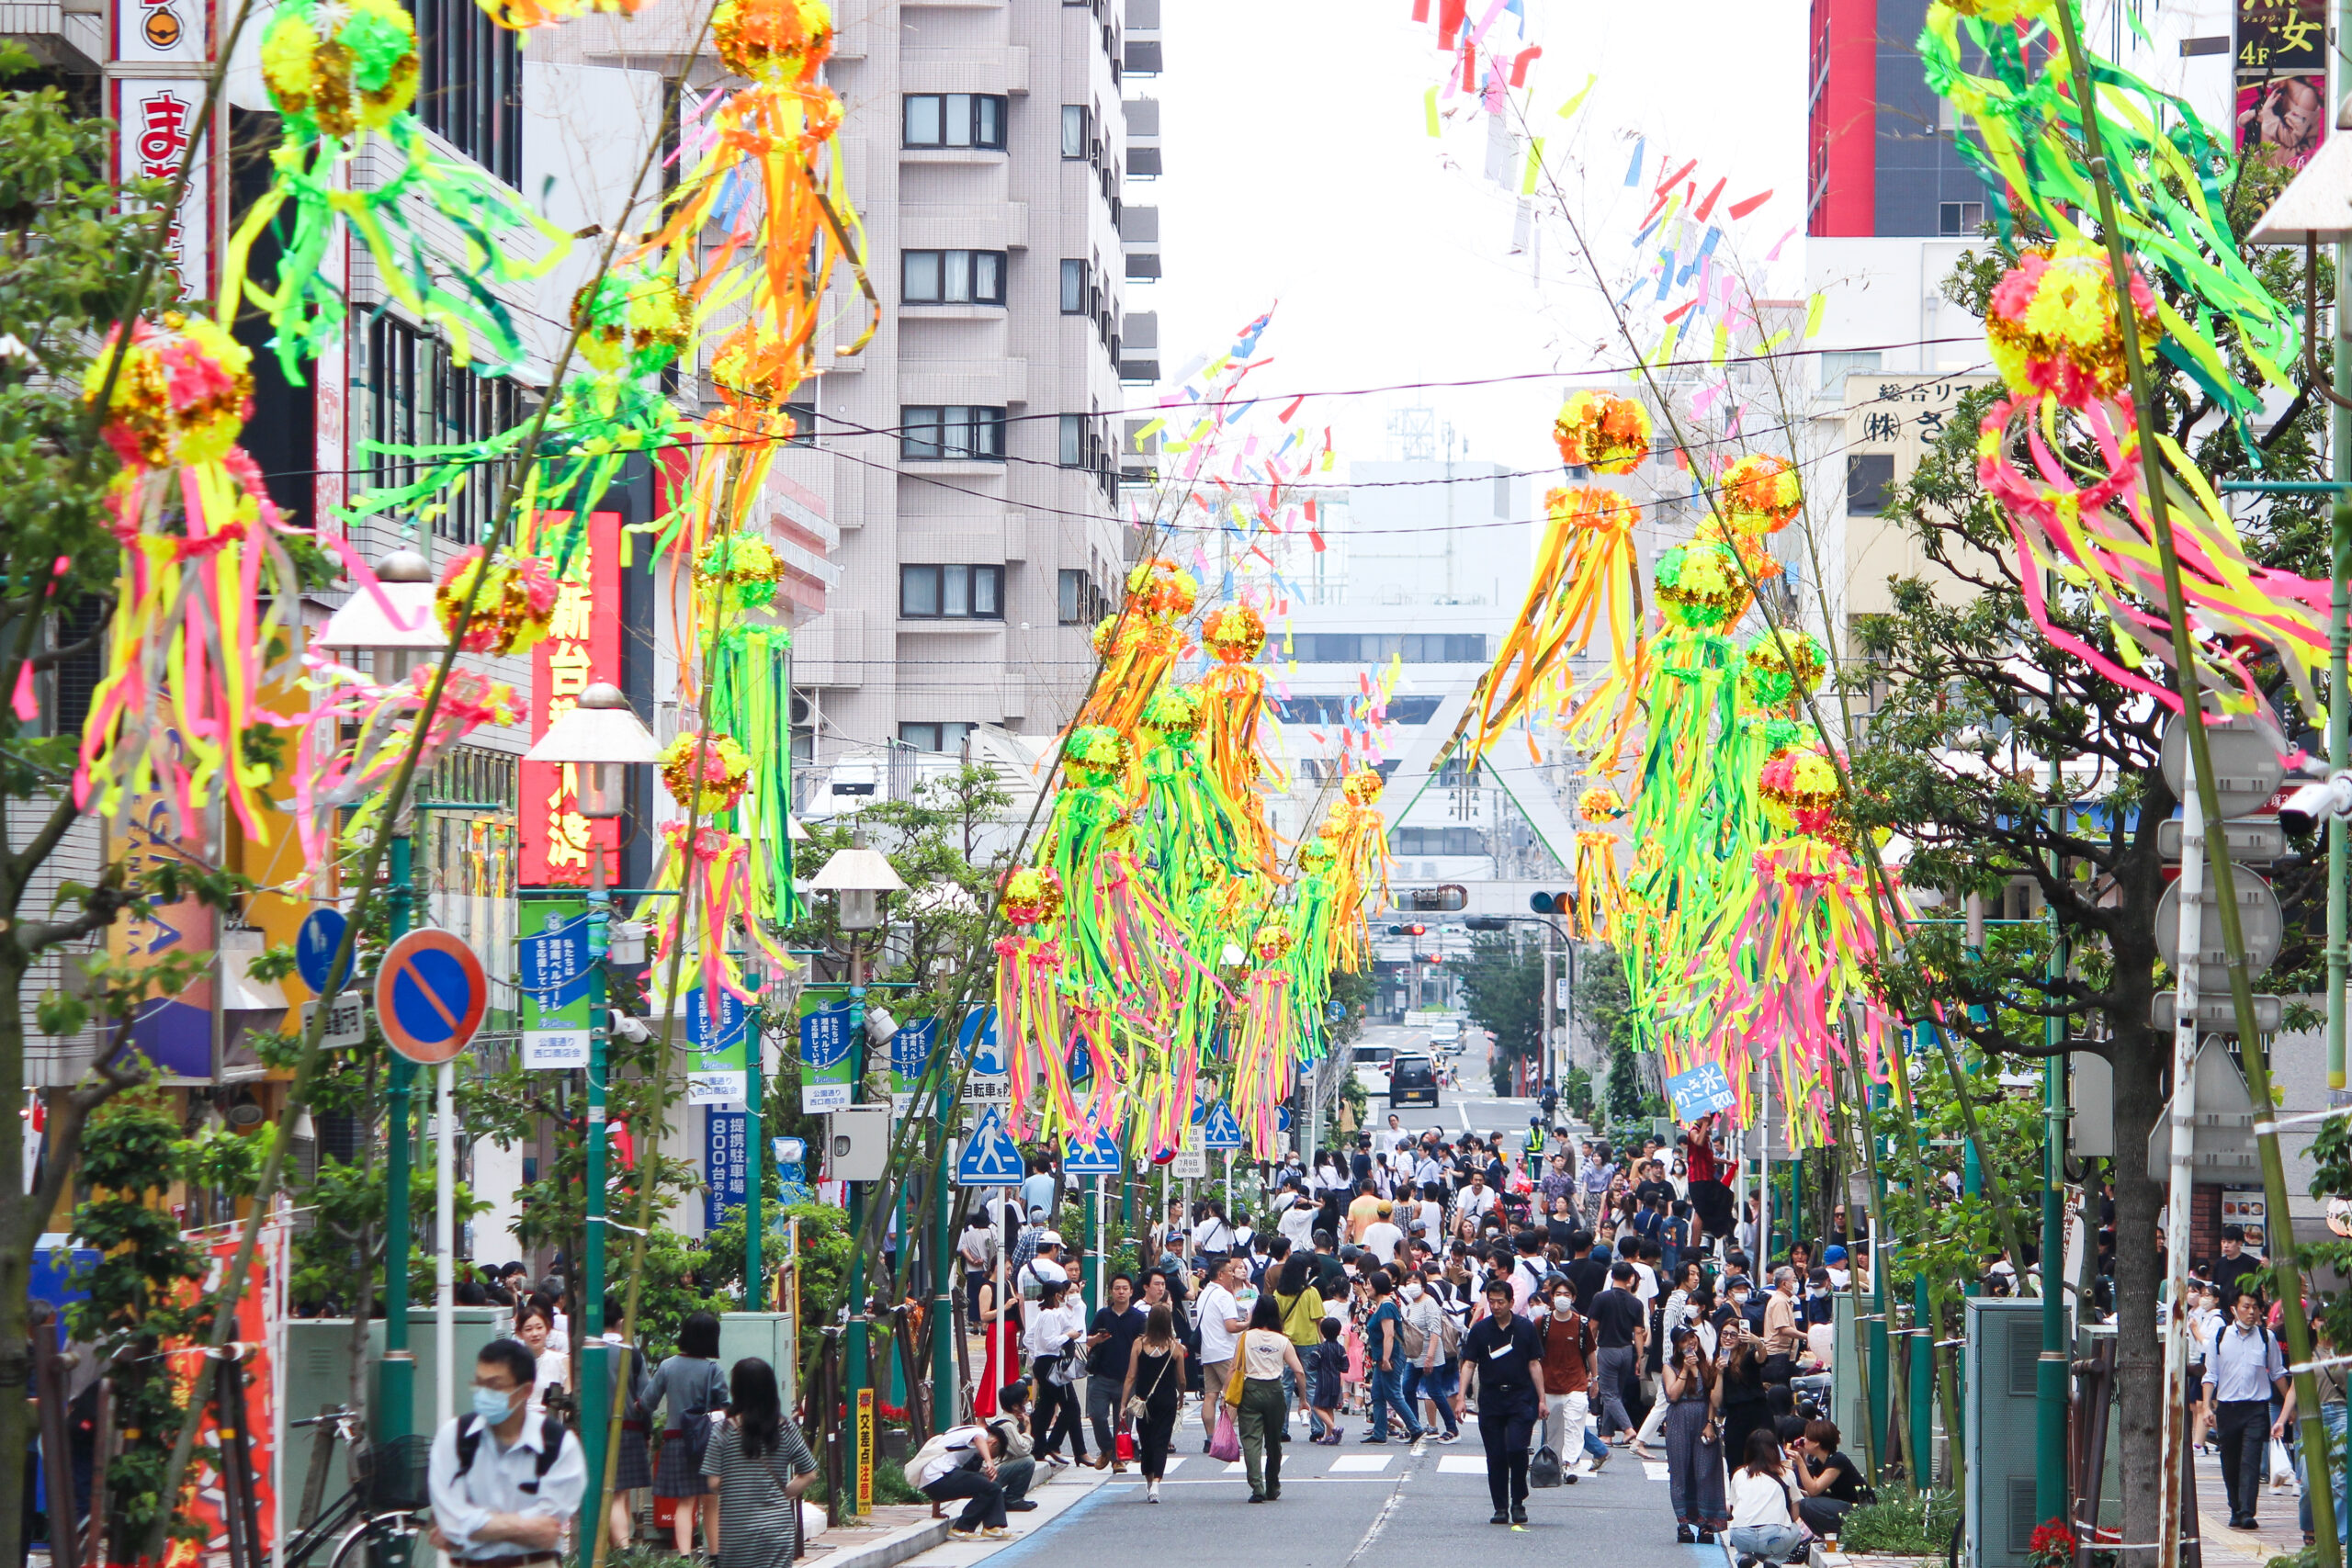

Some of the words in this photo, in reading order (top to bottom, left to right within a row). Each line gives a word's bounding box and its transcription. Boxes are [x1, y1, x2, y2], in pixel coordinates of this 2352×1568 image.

[2239, 40, 2270, 65] 4F
[563, 939, 575, 976] 私たちは
[722, 992, 732, 1025] 私たちは
[534, 1048, 581, 1058] 西口商店会
[538, 1037, 575, 1047] 公園通り
[820, 1017, 831, 1071] 湘南ベルマーレ
[697, 1087, 738, 1096] 西口商店会
[810, 1097, 844, 1106] 西口商店会
[813, 1089, 841, 1098] 公園通り
[1674, 1066, 1725, 1109] かき氷
[712, 1119, 727, 1223] 800台あります
[729, 1118, 745, 1194] 提携駐車場
[860, 1414, 870, 1499] 交差点注意
